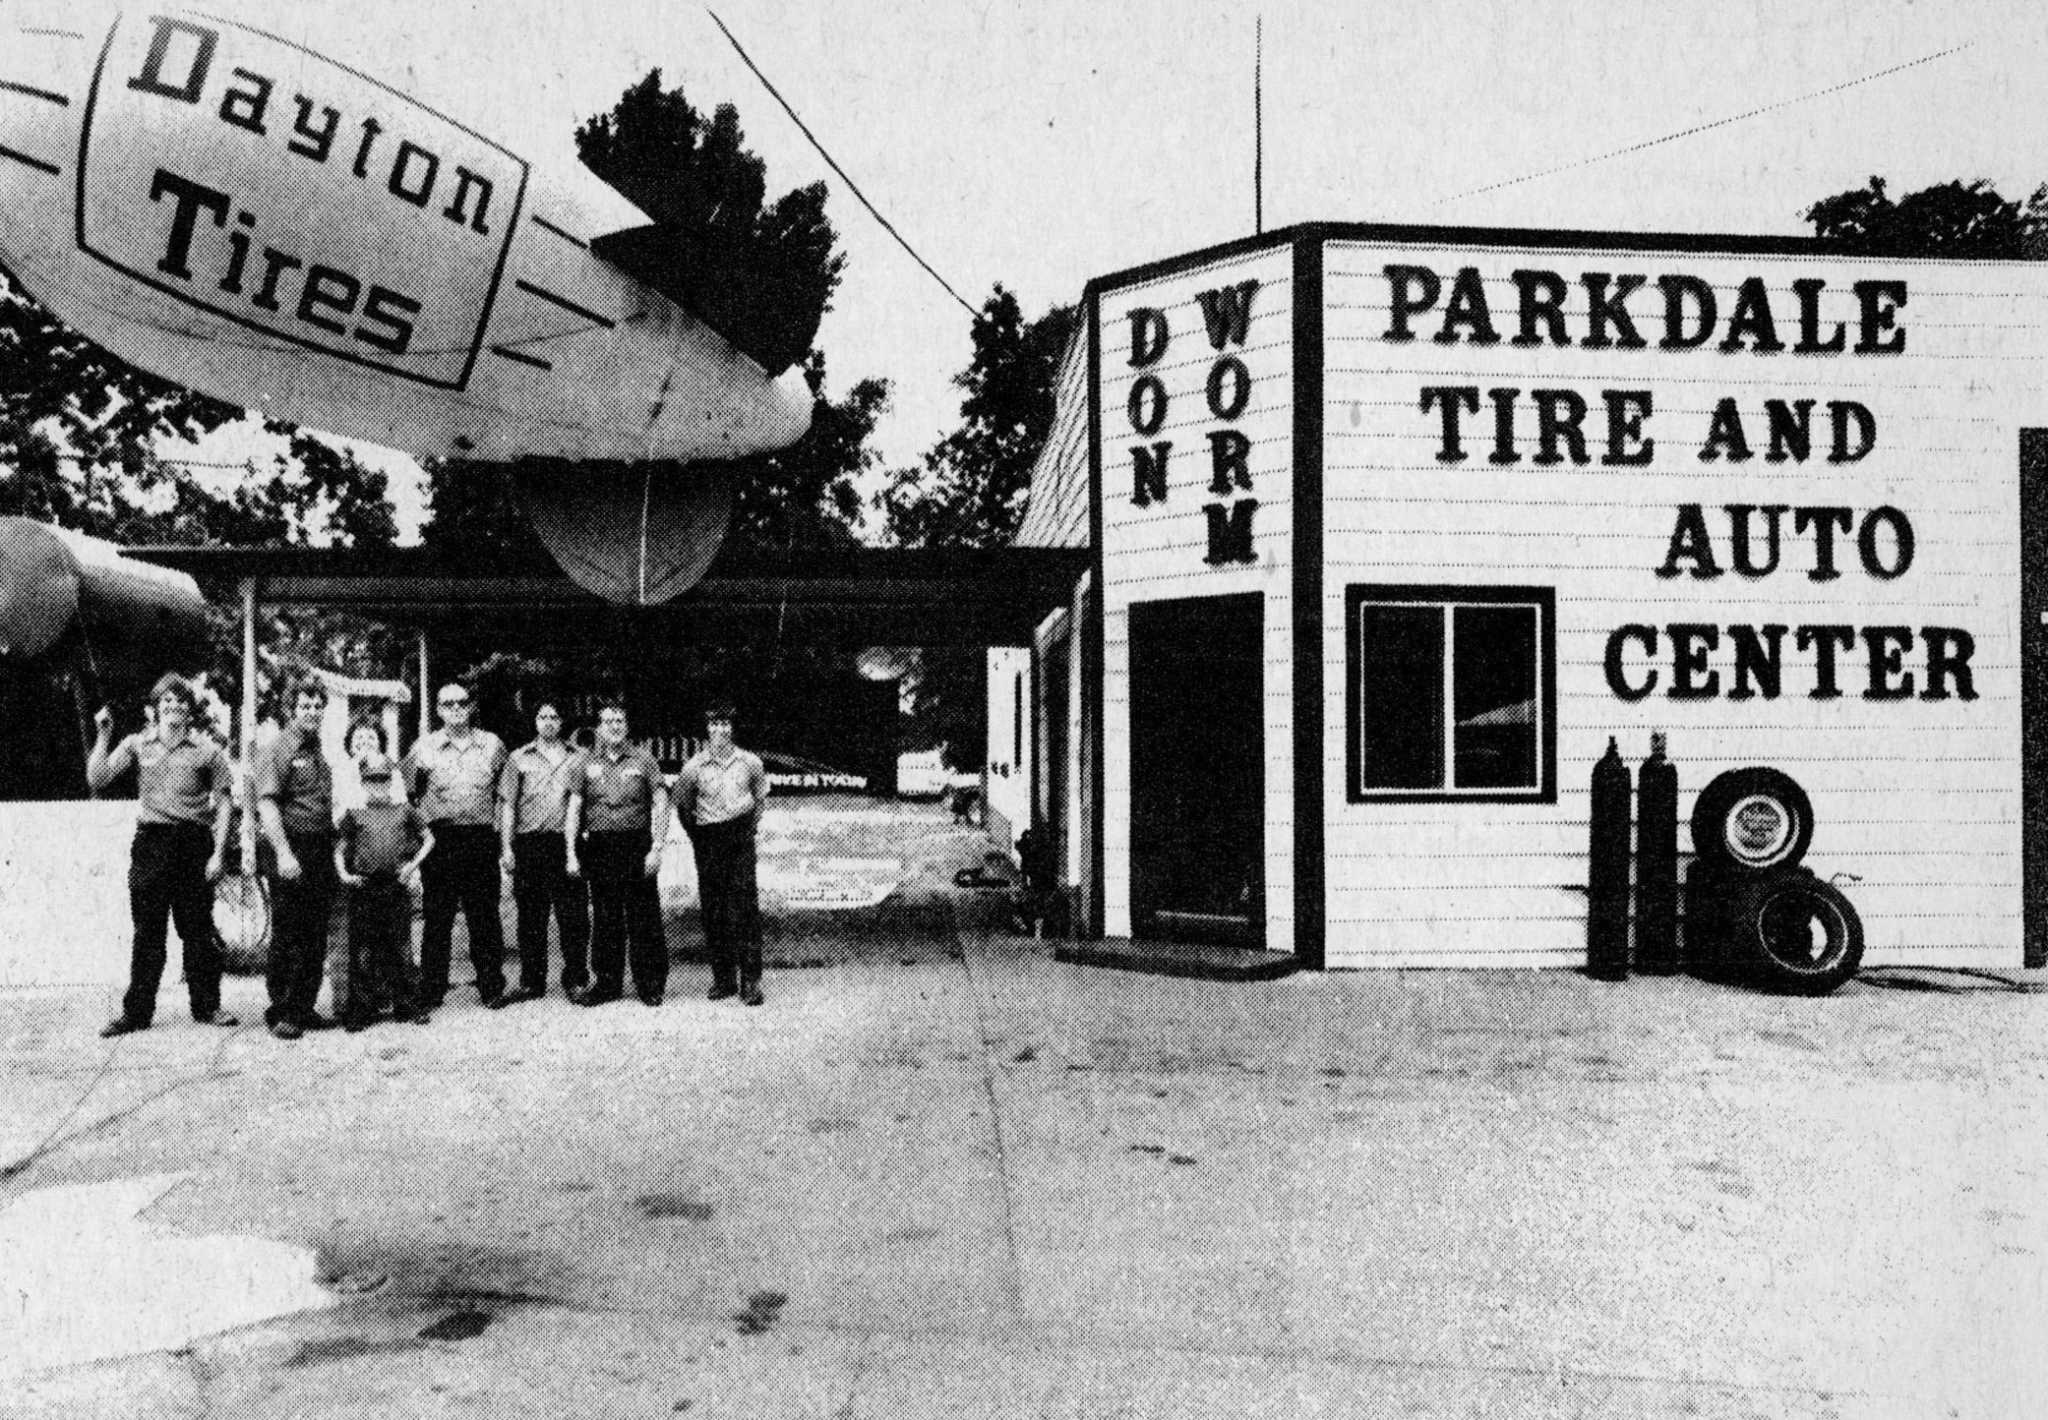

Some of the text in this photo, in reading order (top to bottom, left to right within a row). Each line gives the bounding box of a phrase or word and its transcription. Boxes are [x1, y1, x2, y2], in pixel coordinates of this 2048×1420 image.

[127, 15, 496, 236] Dayton
[149, 169, 421, 355] Tires
[1383, 265, 1908, 355] PARKDALE
[1127, 306, 1170, 508] DON
[1196, 279, 1260, 566] WORM
[1420, 387, 1876, 466] TIRE AND
[1656, 504, 1915, 581] AUTO
[1603, 623, 1979, 702] CENTER
